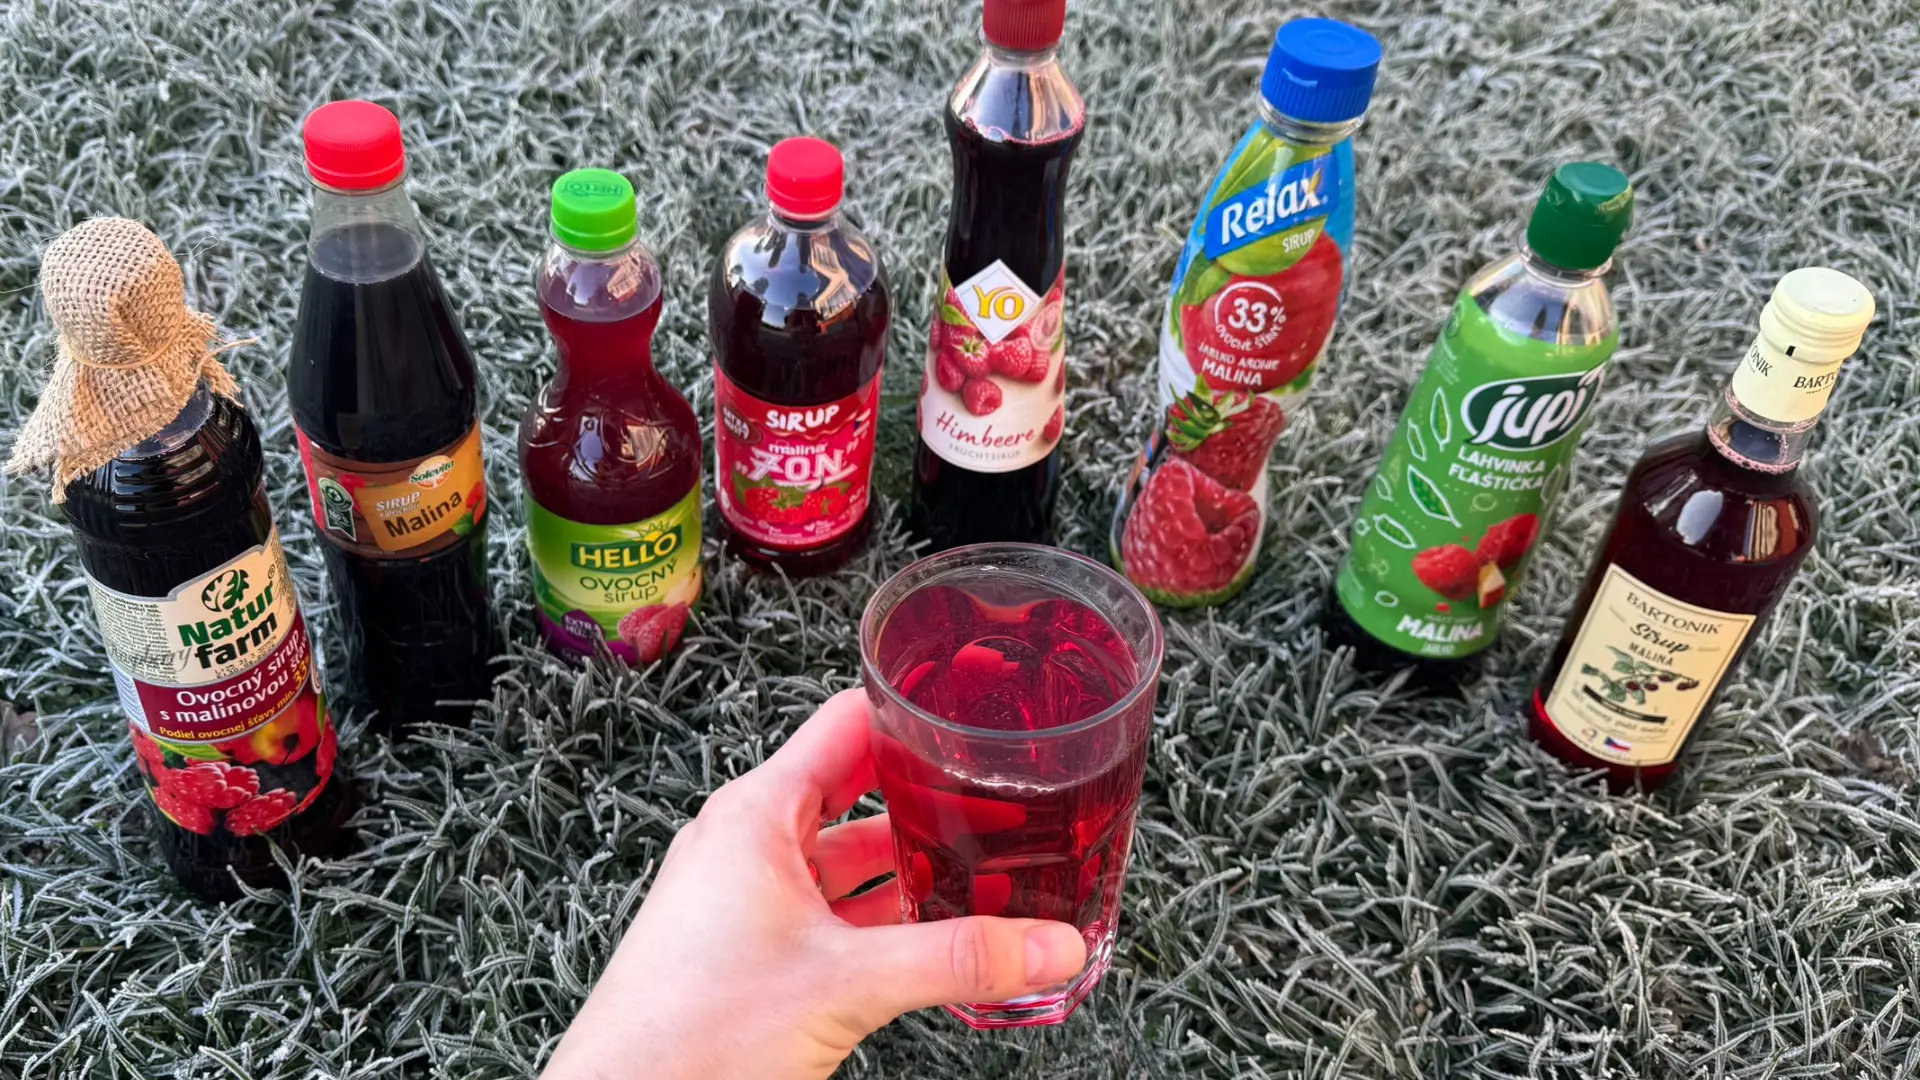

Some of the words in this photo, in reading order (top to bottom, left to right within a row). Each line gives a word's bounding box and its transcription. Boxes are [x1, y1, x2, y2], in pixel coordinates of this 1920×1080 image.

[1221, 168, 1321, 246] Relax
[1282, 228, 1316, 253] SIRUP
[972, 284, 1025, 321] YO
[1201, 360, 1262, 386] MALINA
[766, 405, 839, 432] SIRUP
[936, 410, 1035, 448] Himbeere
[768, 443, 828, 456] malina
[1457, 446, 1545, 474] LAHVINKA
[376, 491, 420, 512] SIRUP
[384, 491, 463, 538] Malina
[579, 532, 677, 568] HELLO
[580, 558, 677, 591] OVOCNÝ
[605, 585, 658, 604] sirup
[178, 580, 274, 647] Natur
[1396, 614, 1483, 642] MALINA
[194, 612, 278, 669] farm
[1629, 623, 1692, 654] Sirup
[176, 668, 263, 706] Ovocný
[267, 629, 300, 676] sirup
[1627, 642, 1674, 667] MALINA
[160, 710, 170, 721] s
[175, 670, 289, 723] malinovou
[160, 726, 195, 741] Podiel
[198, 721, 245, 740] ovocnej
